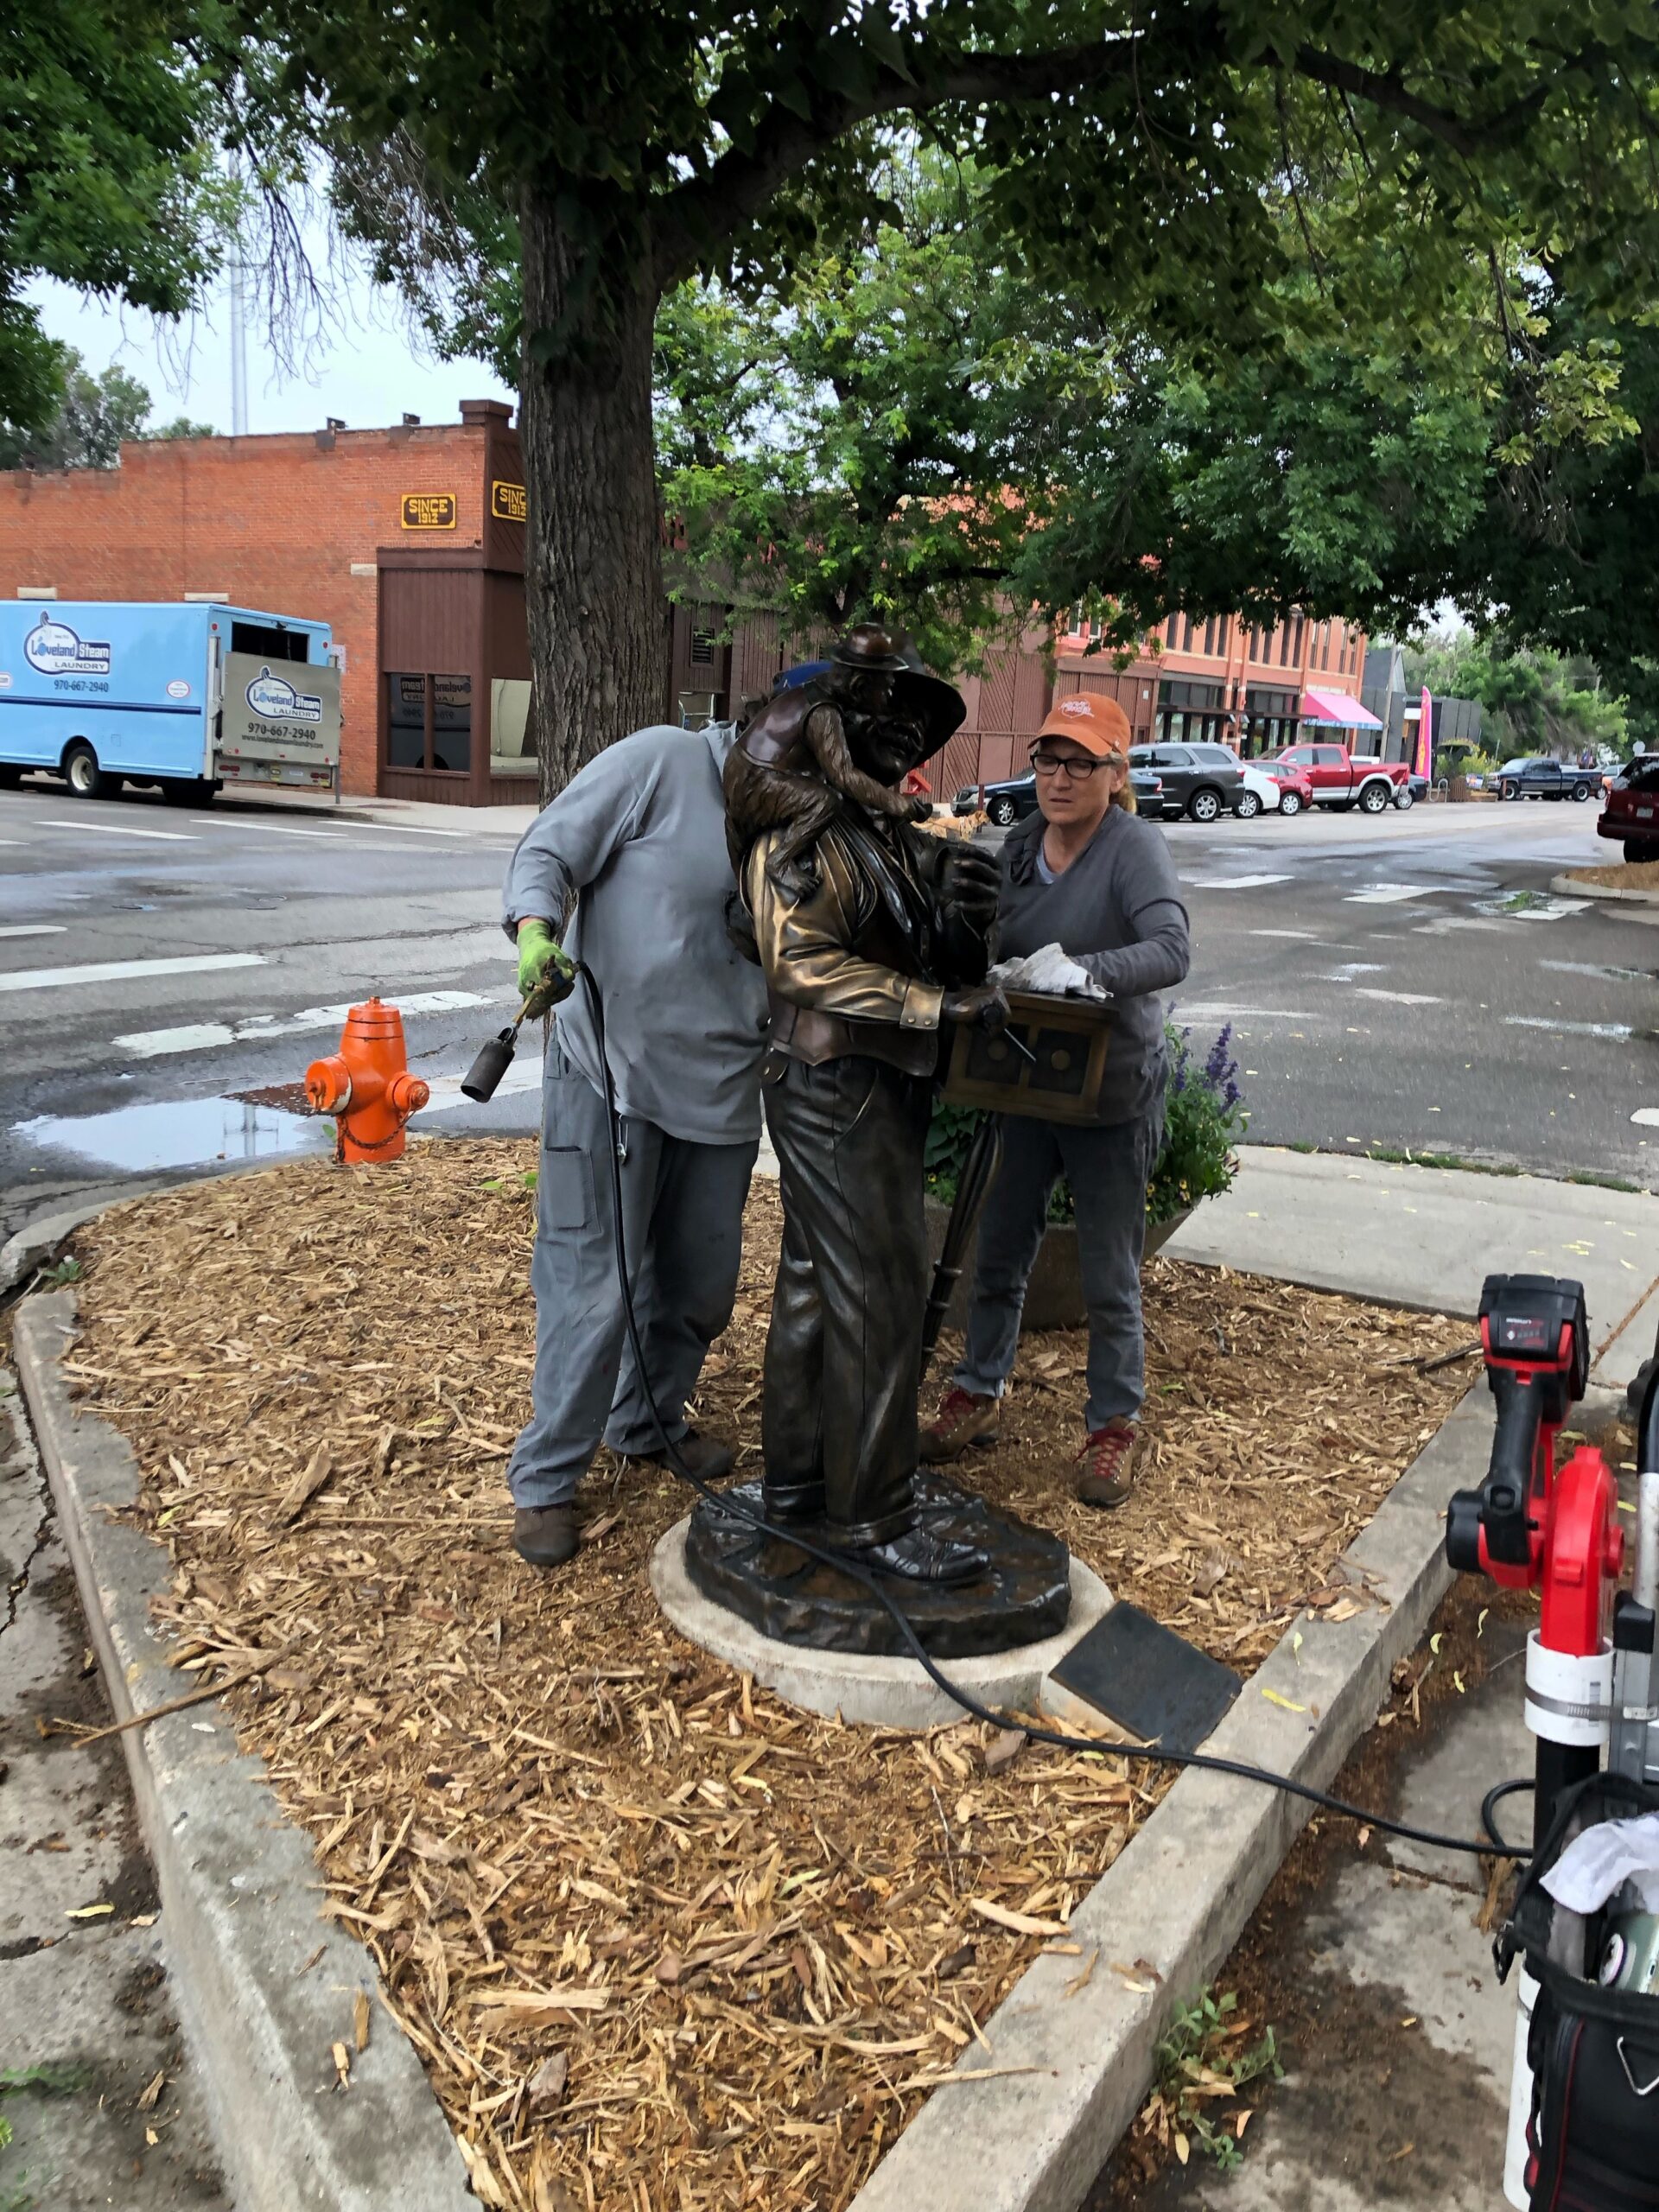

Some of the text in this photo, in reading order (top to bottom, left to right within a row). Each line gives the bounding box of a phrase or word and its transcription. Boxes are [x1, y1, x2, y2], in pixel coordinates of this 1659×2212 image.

[499, 487, 526, 505] SINC
[409, 499, 448, 513] SINCE
[418, 512, 439, 524] 1912
[31, 639, 109, 658] Loveland Steam
[54, 661, 105, 670] LAUNDRY
[54, 679, 109, 692] 970-667-2940
[253, 690, 319, 709] Loveland Steam
[274, 708, 316, 718] LAUNDRY
[248, 722, 315, 740] 970-667-2940
